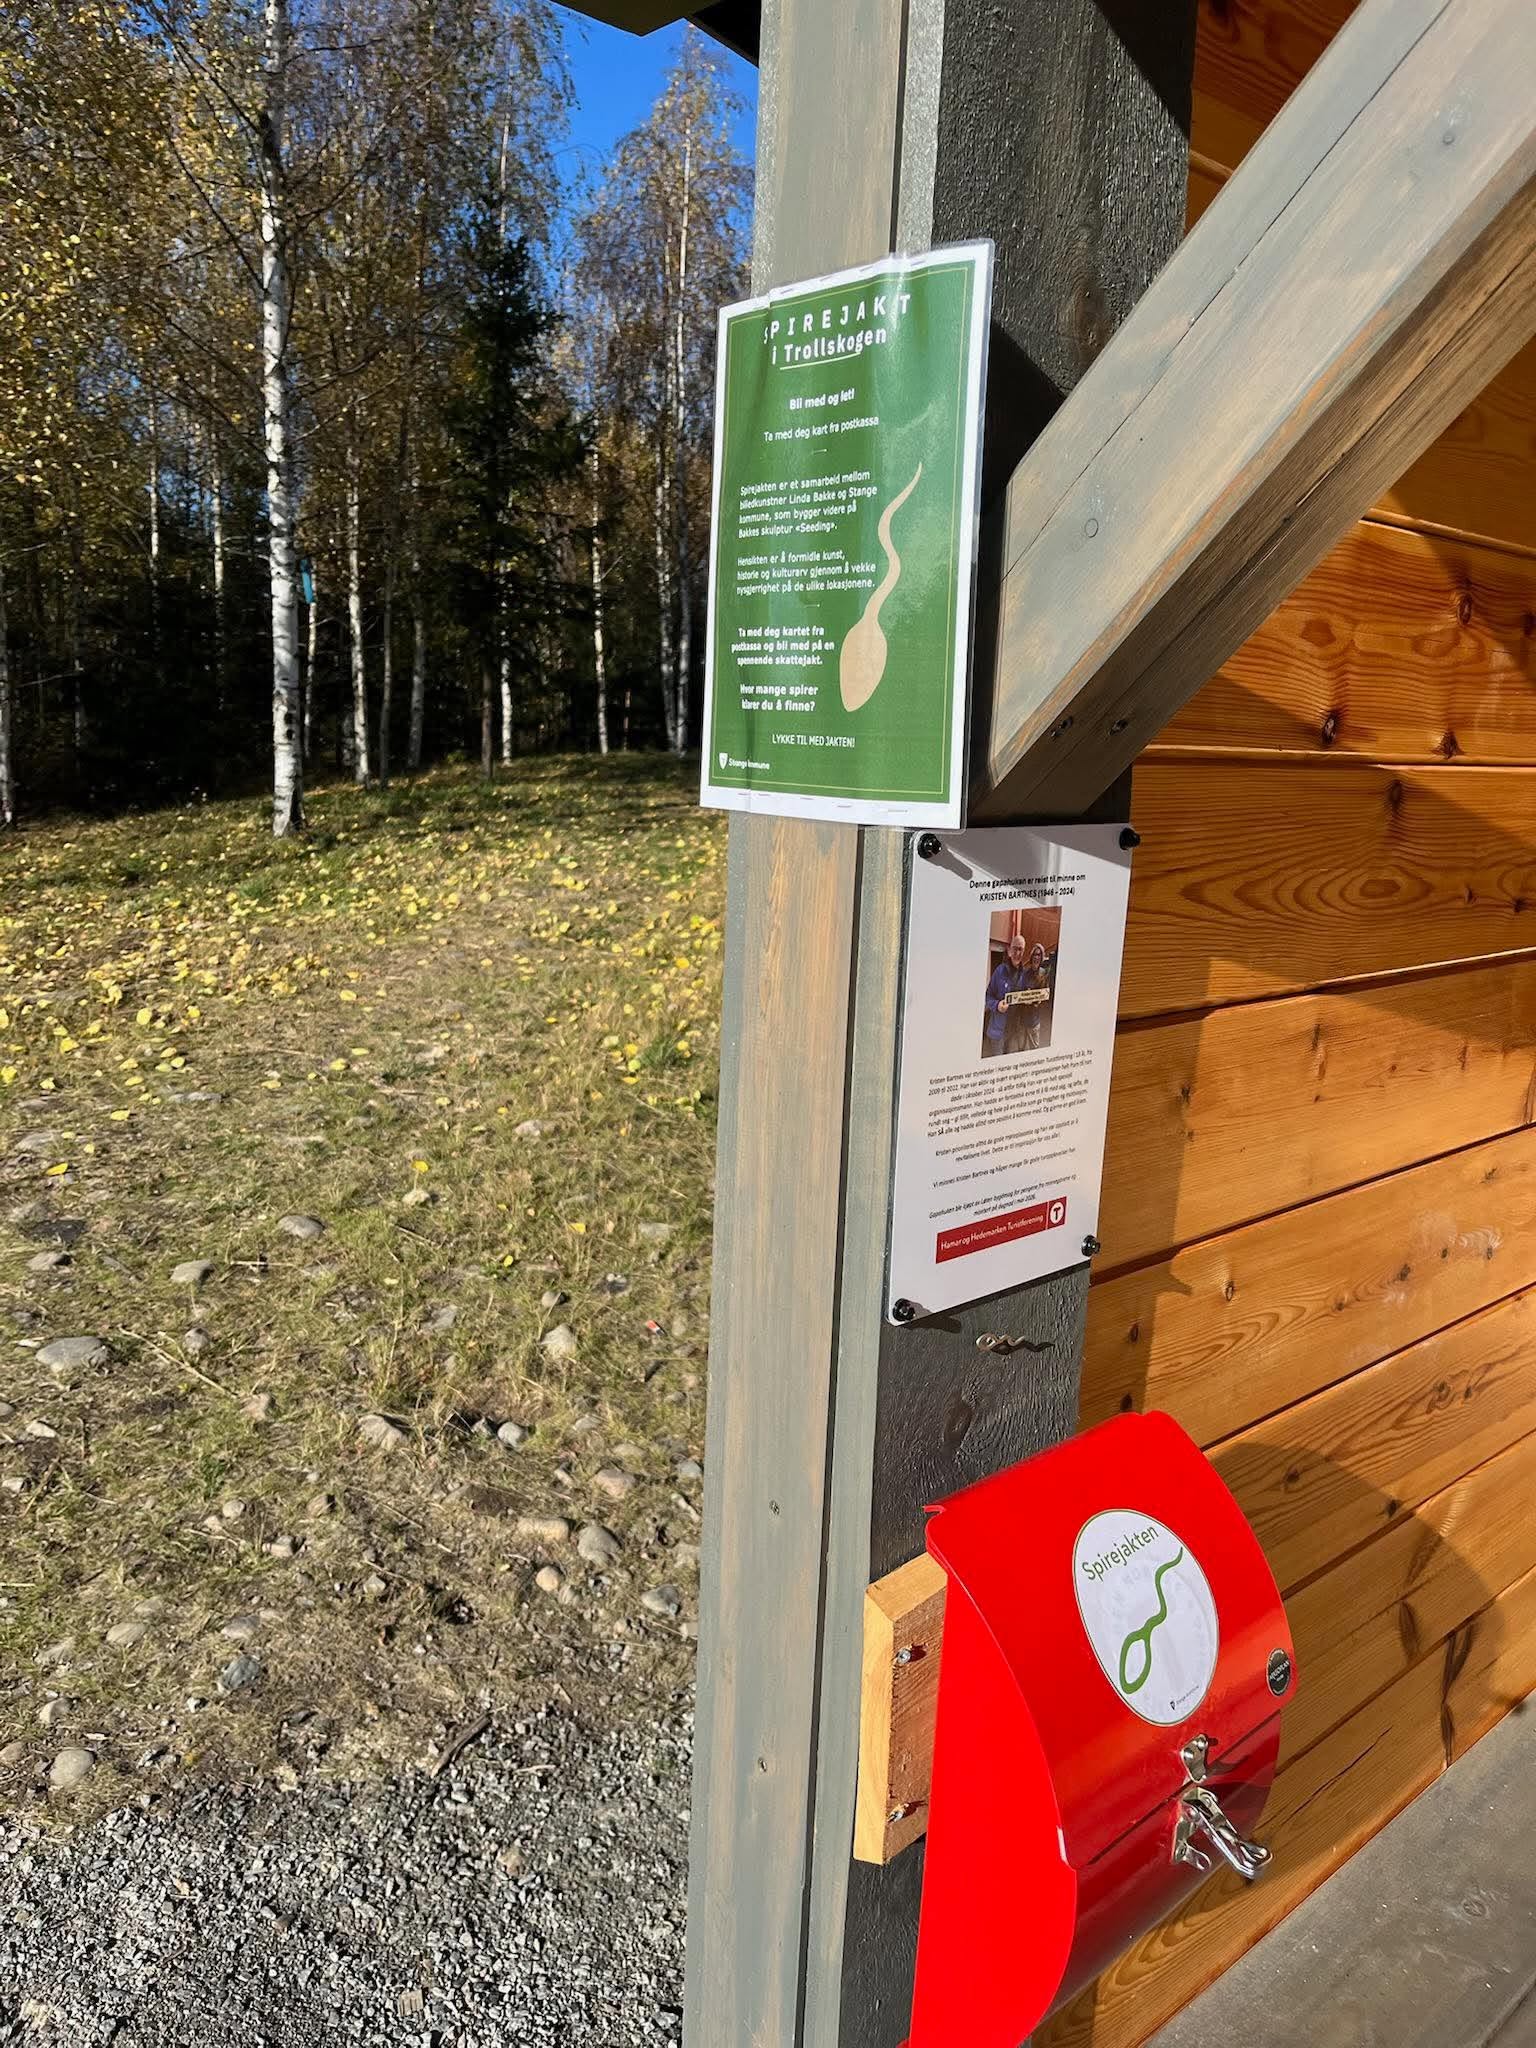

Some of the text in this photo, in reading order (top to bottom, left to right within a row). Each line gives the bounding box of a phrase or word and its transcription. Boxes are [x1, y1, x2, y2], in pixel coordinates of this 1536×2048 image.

[764, 294, 910, 344] SPIREJAKT
[772, 328, 887, 365] i Trollskogen
[790, 398, 802, 409] Bli
[805, 394, 825, 408] med
[828, 394, 839, 405] og
[764, 417, 879, 441] Ta med deg kart fra postkassa
[741, 471, 870, 496] Spirejakten er et samarbeid mellom
[789, 494, 810, 504] Linda
[814, 491, 836, 501] Bakke
[838, 491, 846, 500] og
[848, 486, 877, 498] Stange
[774, 511, 790, 519] som
[794, 508, 820, 519] bygger
[823, 505, 845, 515] videre
[847, 499, 856, 514] på
[739, 528, 759, 538] Bakkes
[761, 524, 792, 536] skulptur
[771, 556, 778, 564] er
[781, 551, 785, 562] å
[788, 551, 820, 562] formidle
[738, 561, 876, 580] historie og kulturarv gjennom å vekke
[737, 584, 779, 596] nysgjerrighet
[782, 580, 791, 593] på
[794, 582, 803, 591] de
[806, 581, 824, 590] ulike
[738, 626, 824, 638] Ta med deg kartet fra
[763, 642, 774, 652] og
[776, 641, 787, 650] bli
[790, 641, 809, 650] med
[812, 639, 822, 652] på
[824, 642, 834, 650] en
[756, 686, 786, 696] mange
[789, 684, 818, 697] spirer
[762, 700, 773, 710] du
[776, 699, 782, 710] å
[785, 700, 815, 711] finne?
[772, 734, 855, 748] LYKKE TIL MED JAKTEN!
[970, 880, 990, 888] Denne
[1057, 874, 1075, 882] minne
[980, 892, 1007, 901] KRISTEN
[941, 1240, 961, 1250] Hamar
[962, 1236, 970, 1245] og
[971, 1226, 1007, 1240] Hedemarken
[1053, 1207, 1061, 1220] T
[1082, 1526, 1159, 1581] Spirejakten
